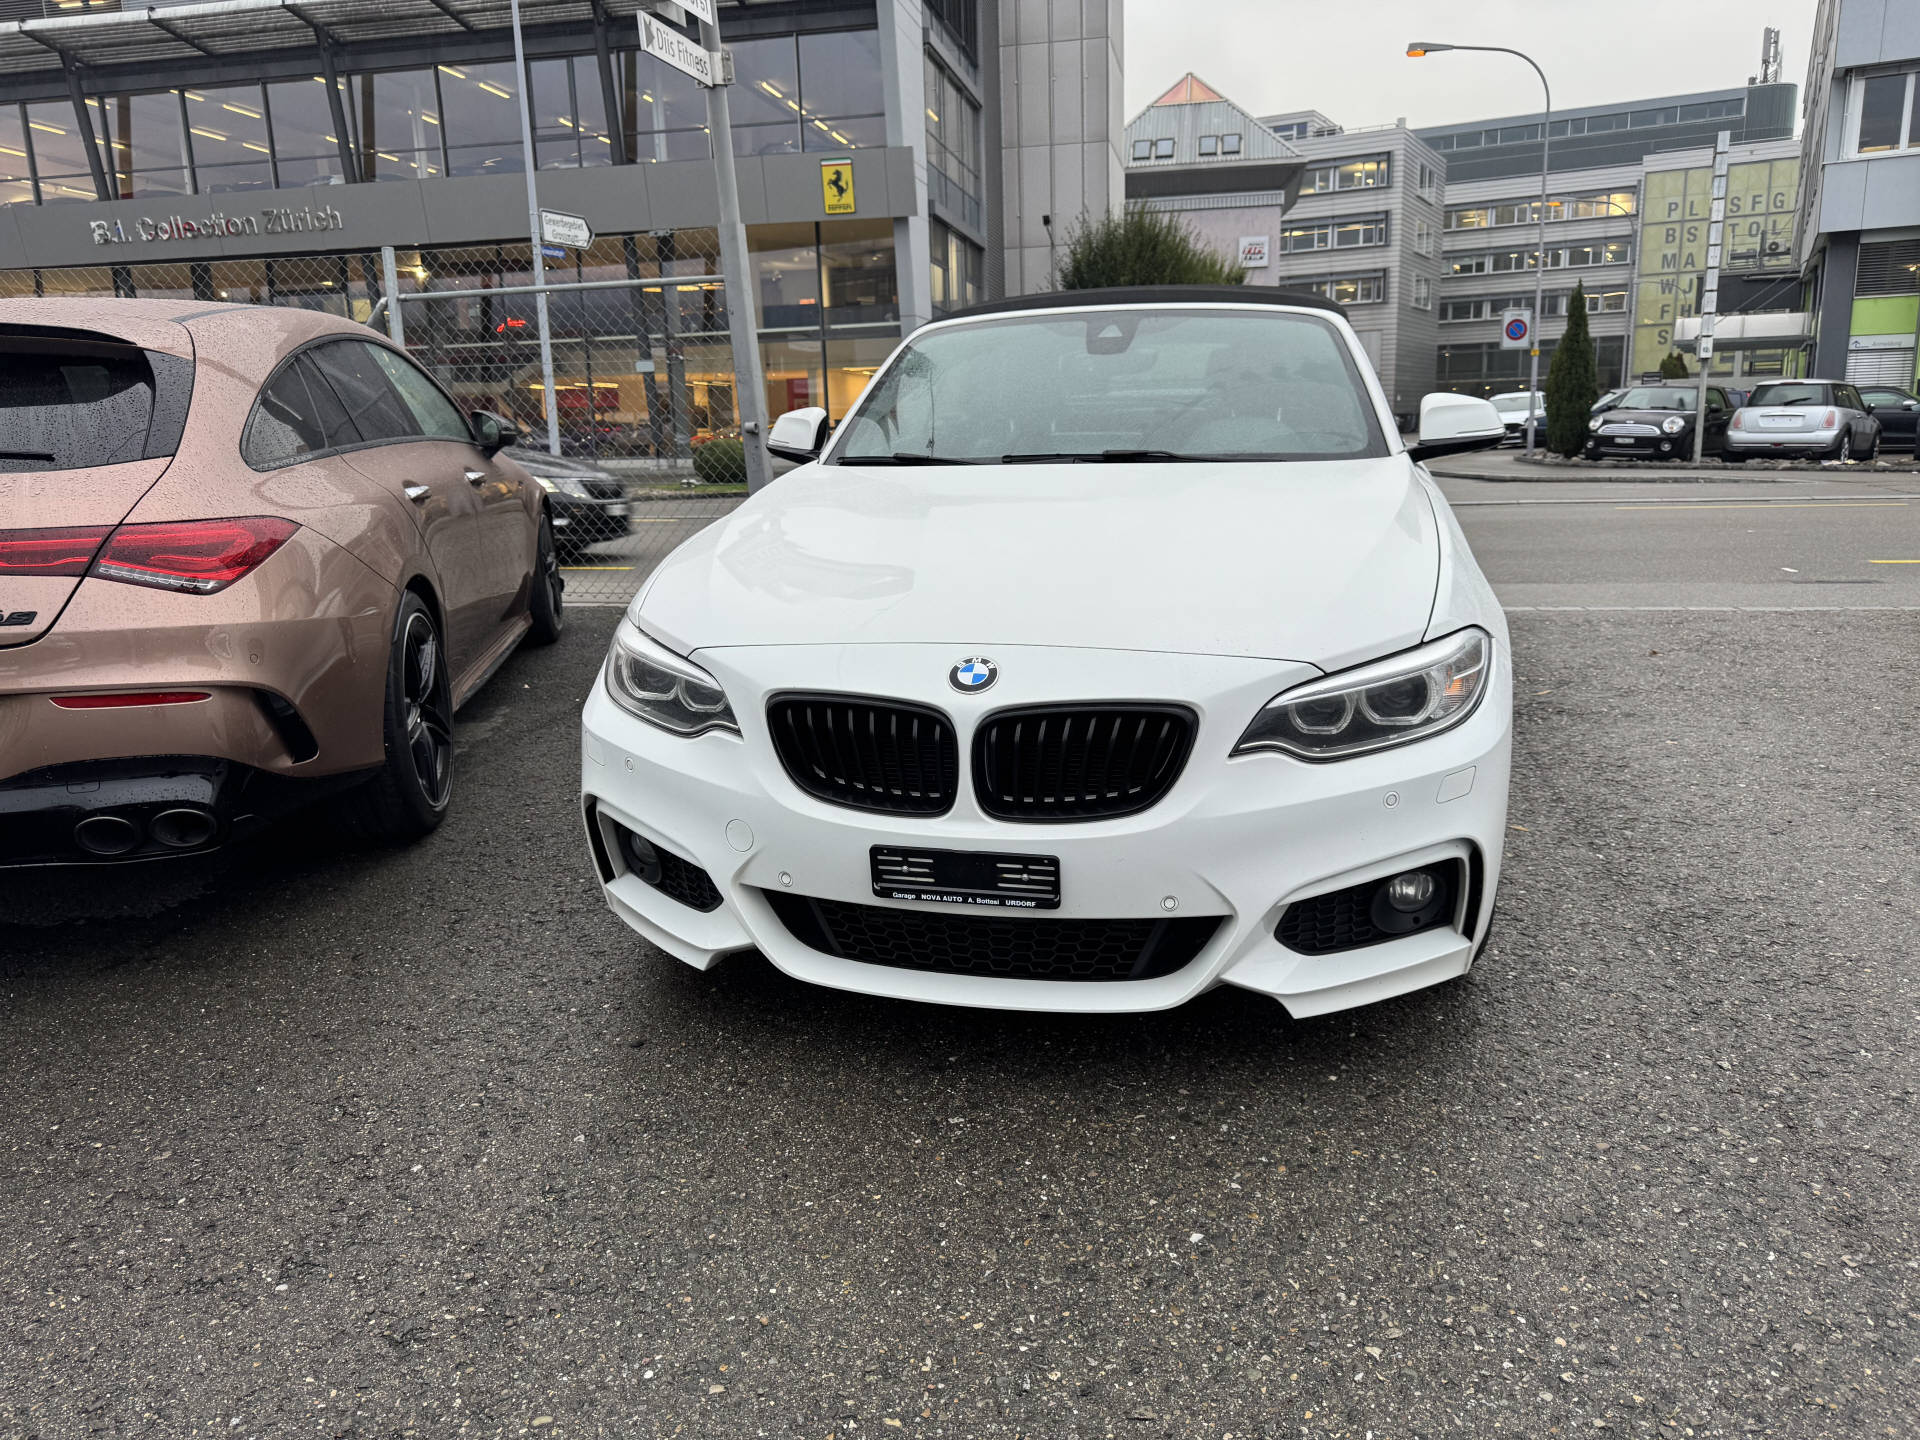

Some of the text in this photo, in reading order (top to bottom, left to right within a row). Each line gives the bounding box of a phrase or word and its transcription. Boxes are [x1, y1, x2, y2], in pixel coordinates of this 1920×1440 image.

[656, 27, 709, 76] Diis Fitness
[136, 213, 258, 241] Collection
[262, 205, 343, 234] Zürich
[892, 892, 916, 900] Garage
[942, 895, 963, 903] AUTO
[1005, 899, 1036, 907] URDORF
